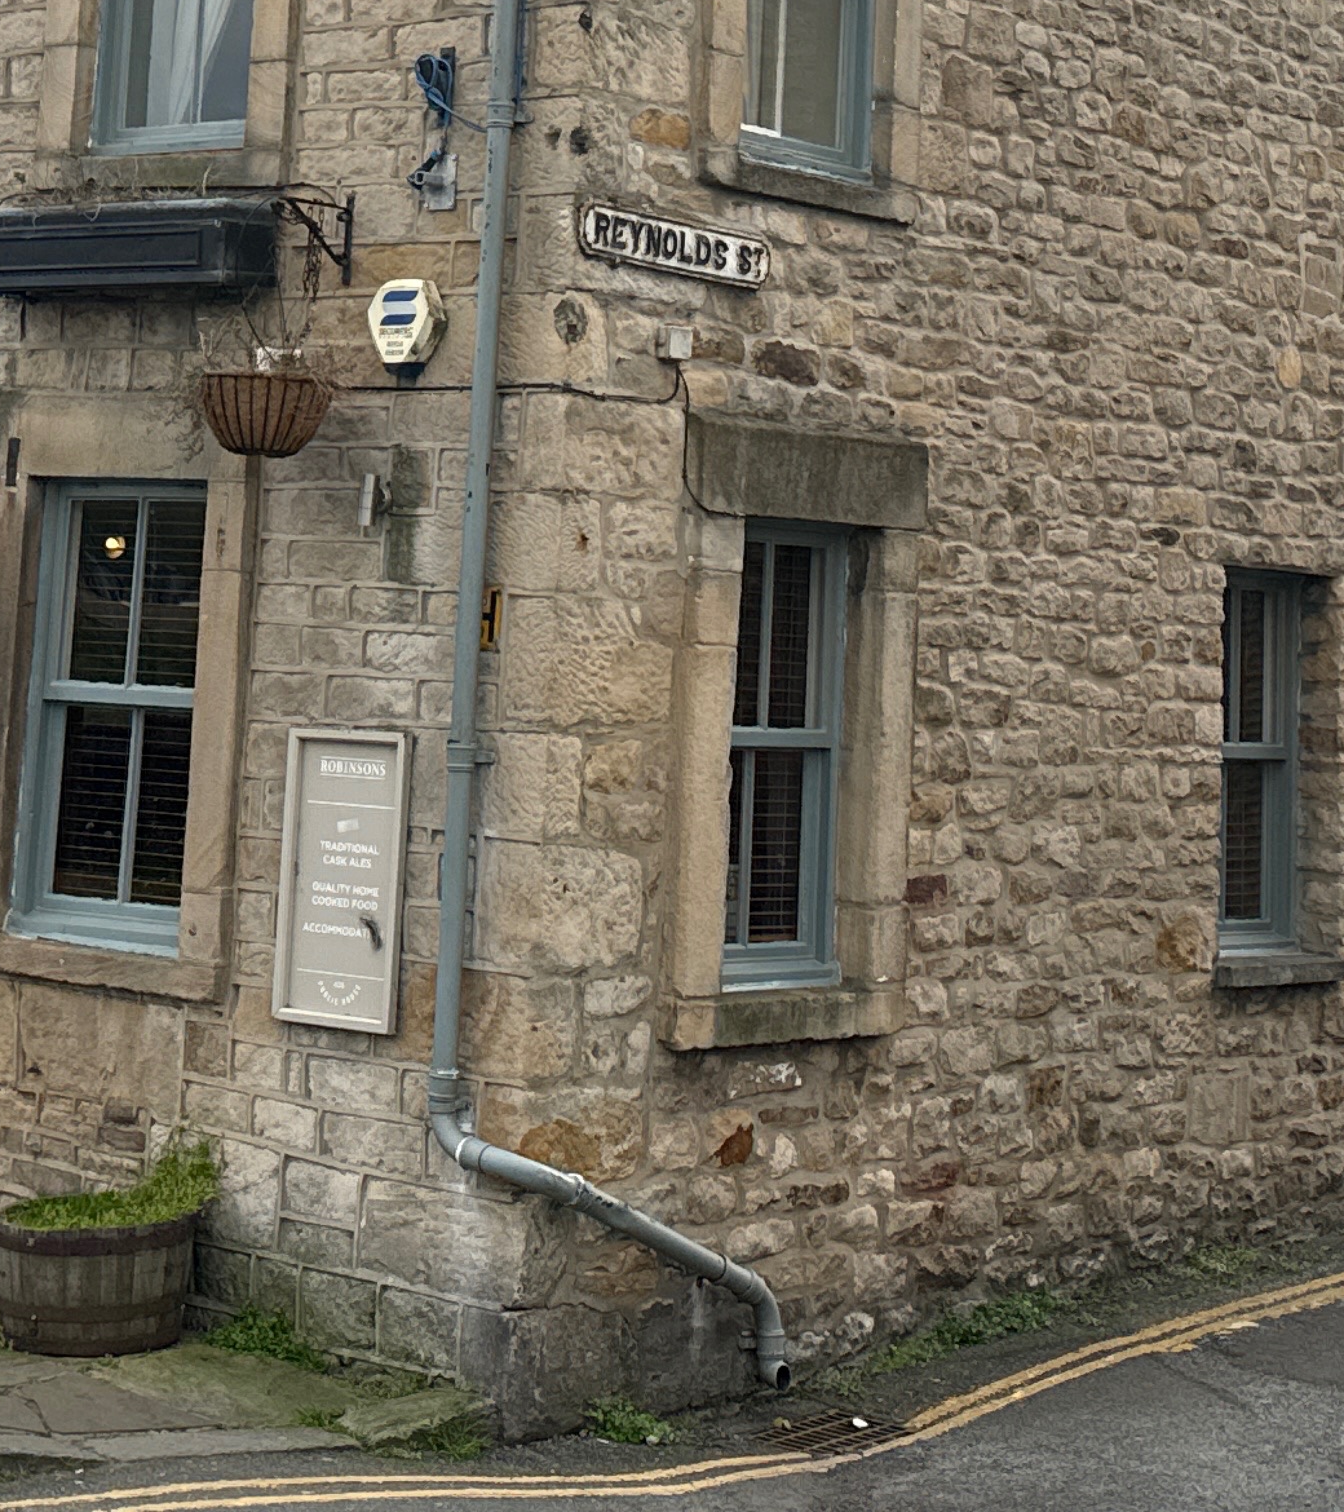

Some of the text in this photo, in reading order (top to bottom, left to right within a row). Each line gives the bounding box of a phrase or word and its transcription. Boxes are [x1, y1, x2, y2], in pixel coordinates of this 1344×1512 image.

[593, 210, 729, 270] REYNOLDS
[320, 759, 386, 777] ROBINSONS
[320, 840, 380, 855] TRADITIONAL
[323, 855, 372, 868] CASK ALES
[312, 881, 379, 898] QUALITY HOME
[312, 895, 378, 911] COOKED FOOD
